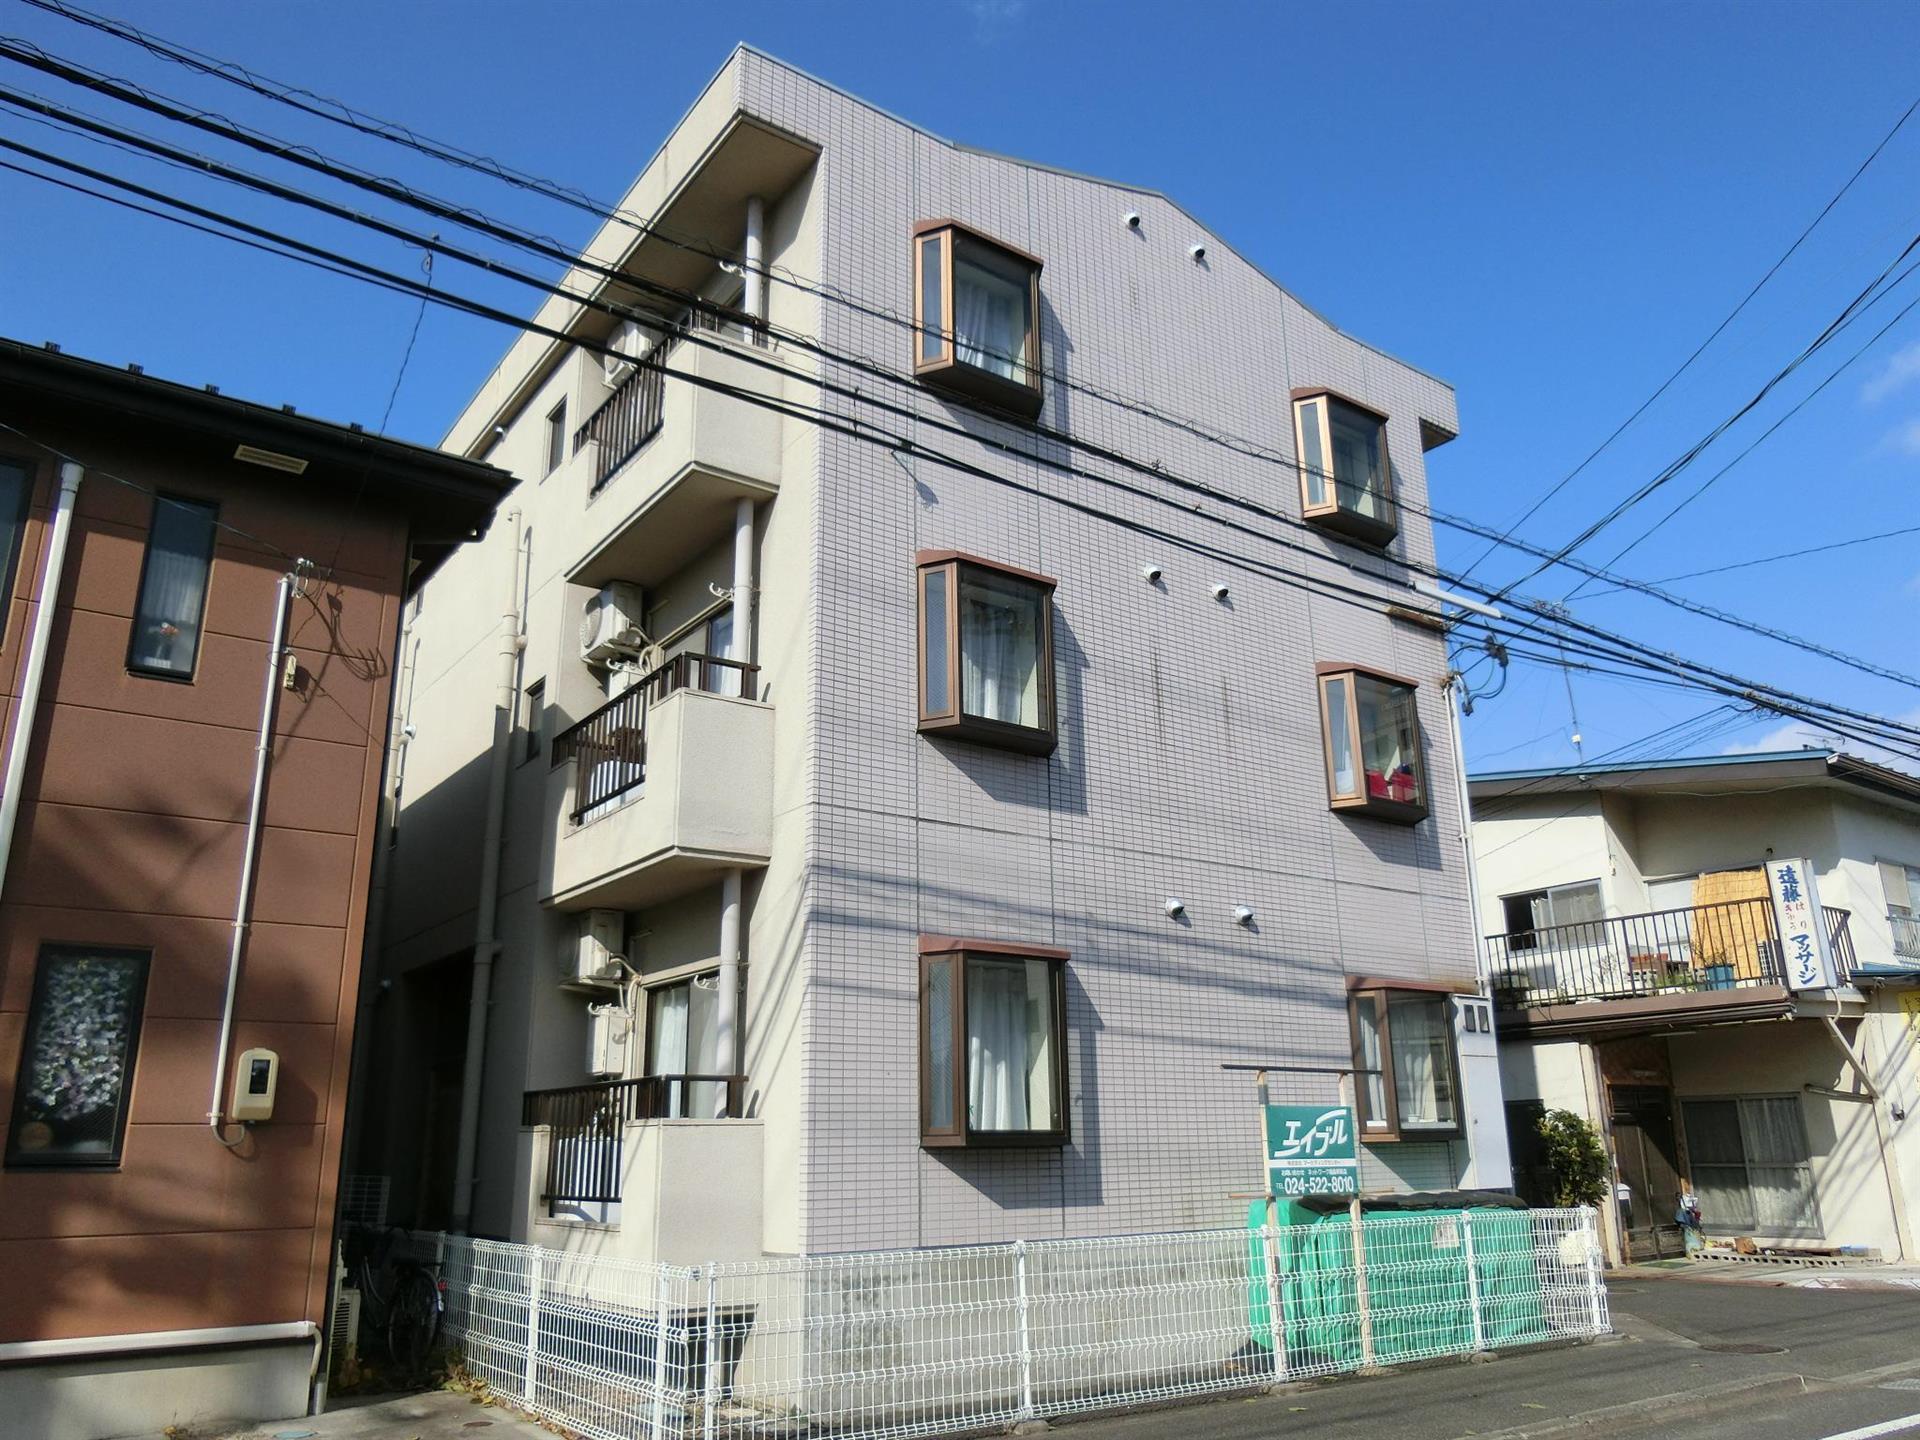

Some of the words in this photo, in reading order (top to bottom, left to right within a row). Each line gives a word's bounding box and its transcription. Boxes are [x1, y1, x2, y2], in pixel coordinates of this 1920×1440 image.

[1777, 864, 1802, 902] 遠藤
[1795, 902, 1807, 929] はり
[1790, 934, 1817, 985] マッサージ
[1274, 1109, 1347, 1158] エイブル
[1275, 1182, 1285, 1190] TEL
[1284, 1176, 1354, 1194] 024-522-8010
